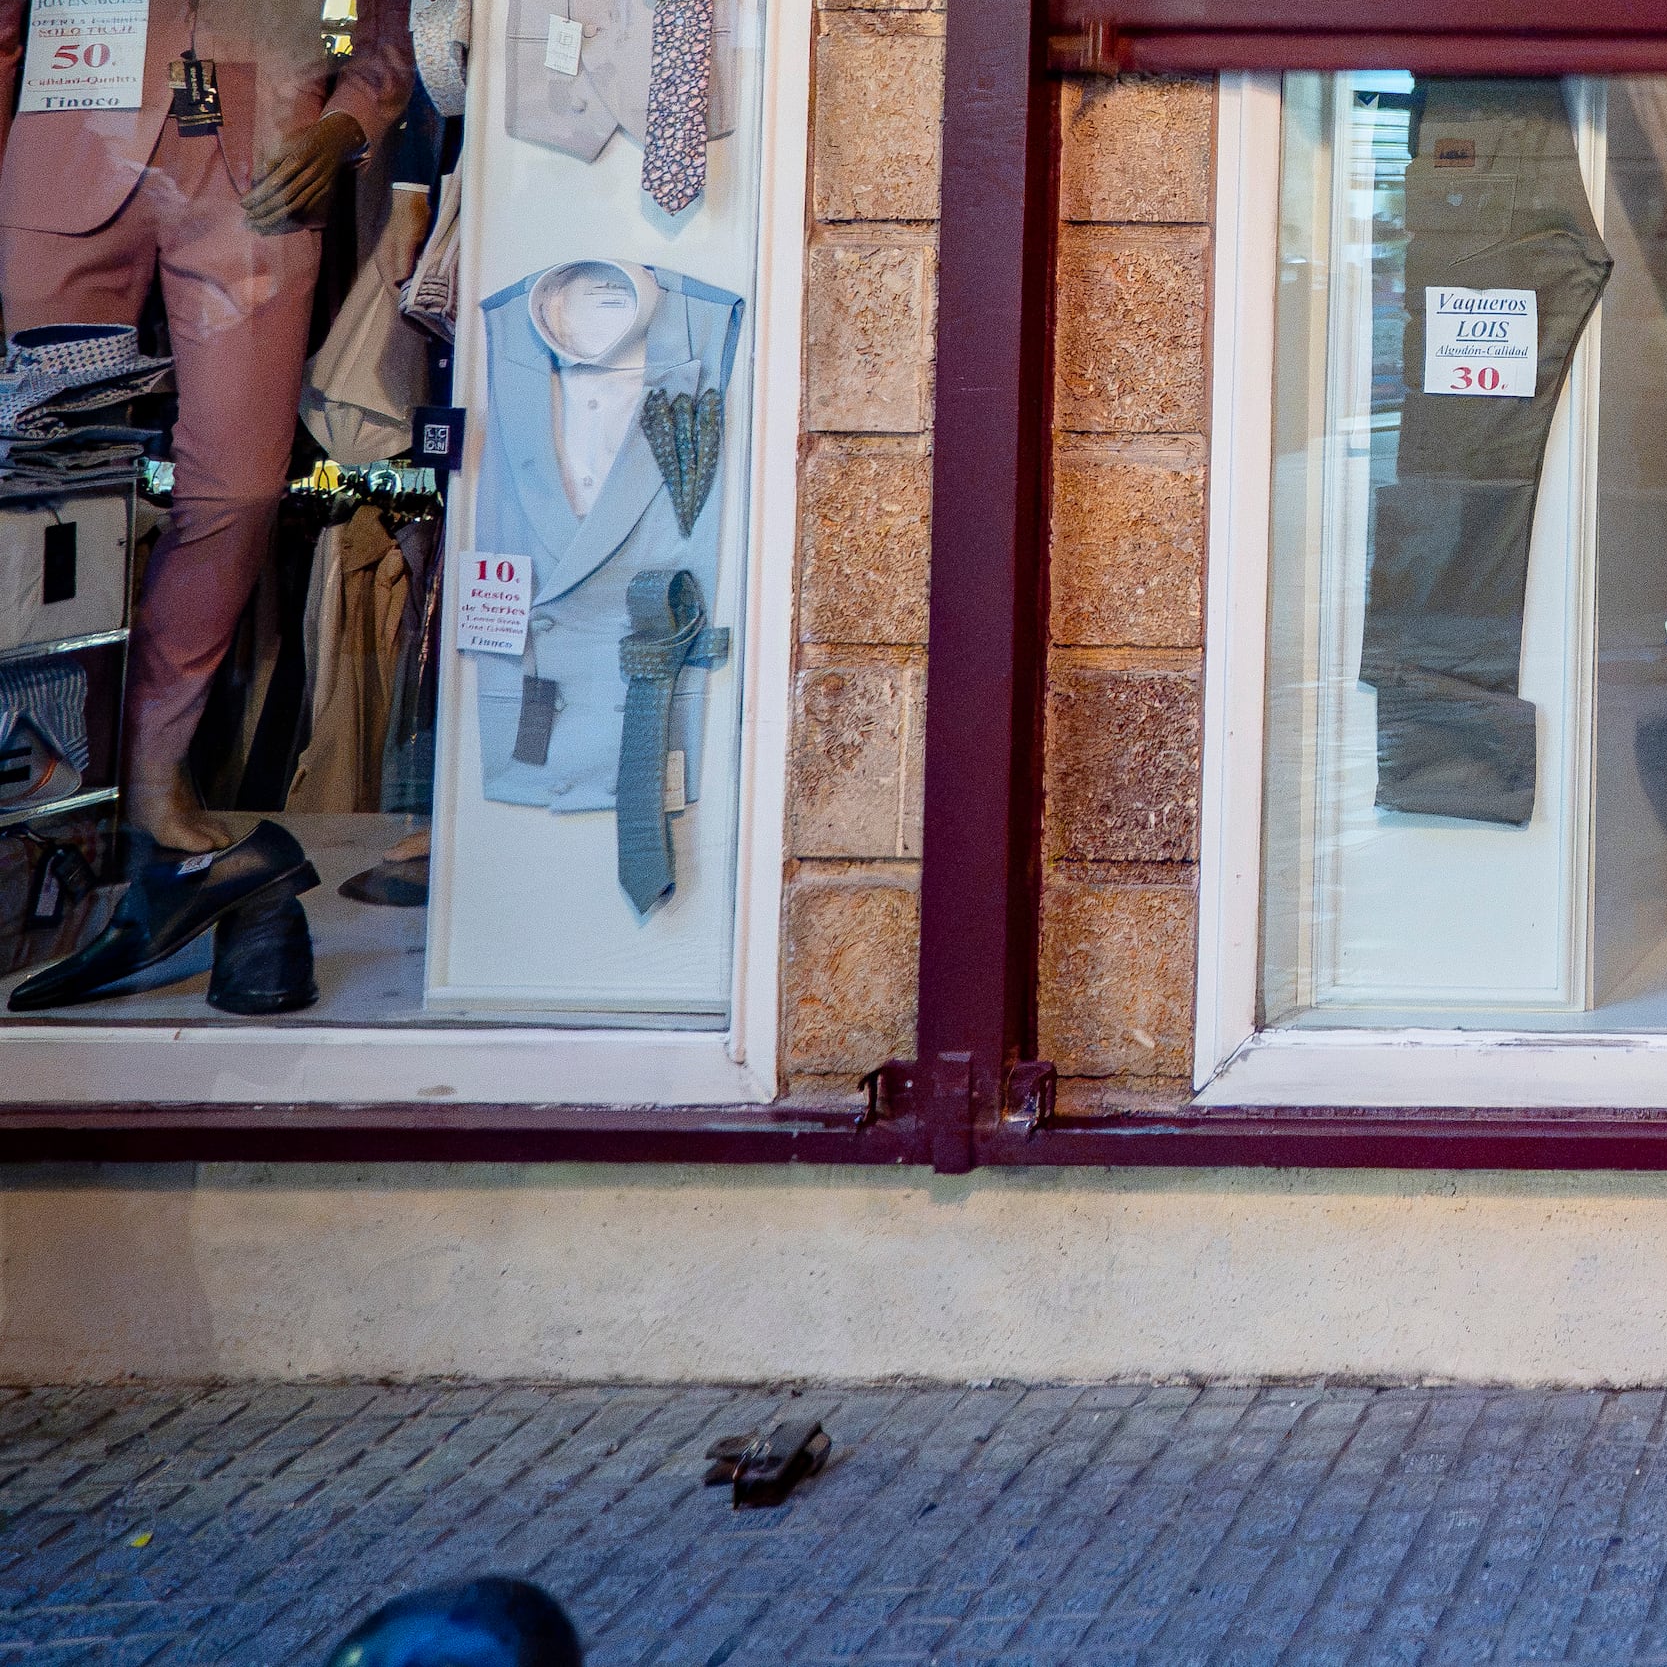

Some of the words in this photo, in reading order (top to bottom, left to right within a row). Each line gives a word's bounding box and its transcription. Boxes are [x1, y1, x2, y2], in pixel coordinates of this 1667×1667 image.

[42, 95, 121, 108] Tinoco
[1440, 293, 1527, 314] Vaqueros
[1456, 320, 1510, 339] LOIS
